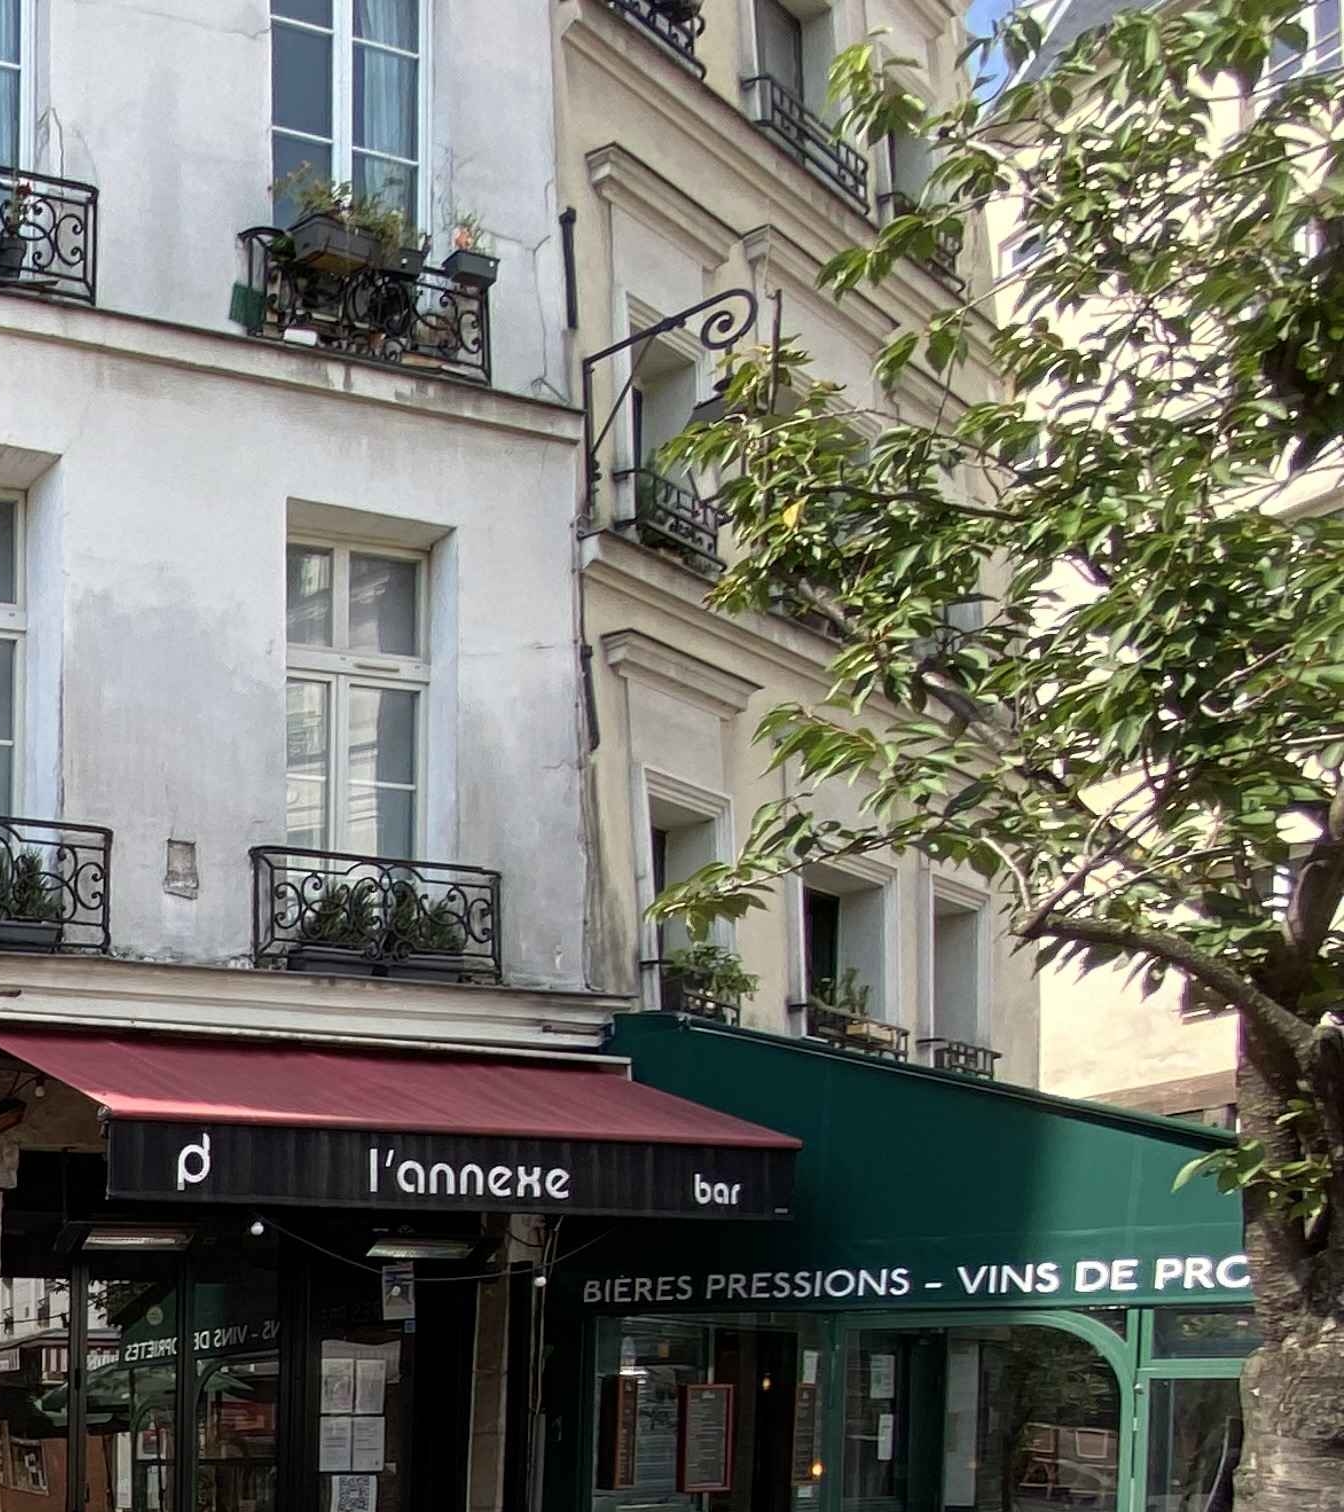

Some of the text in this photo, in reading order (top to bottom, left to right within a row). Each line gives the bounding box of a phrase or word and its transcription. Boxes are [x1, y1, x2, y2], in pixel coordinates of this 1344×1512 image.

[369, 1148, 570, 1199] l'annexe
[694, 1173, 741, 1204] bar
[705, 1267, 910, 1300] PRESSIONS
[957, 1261, 1060, 1295] VINS
[1074, 1259, 1139, 1293] DE
